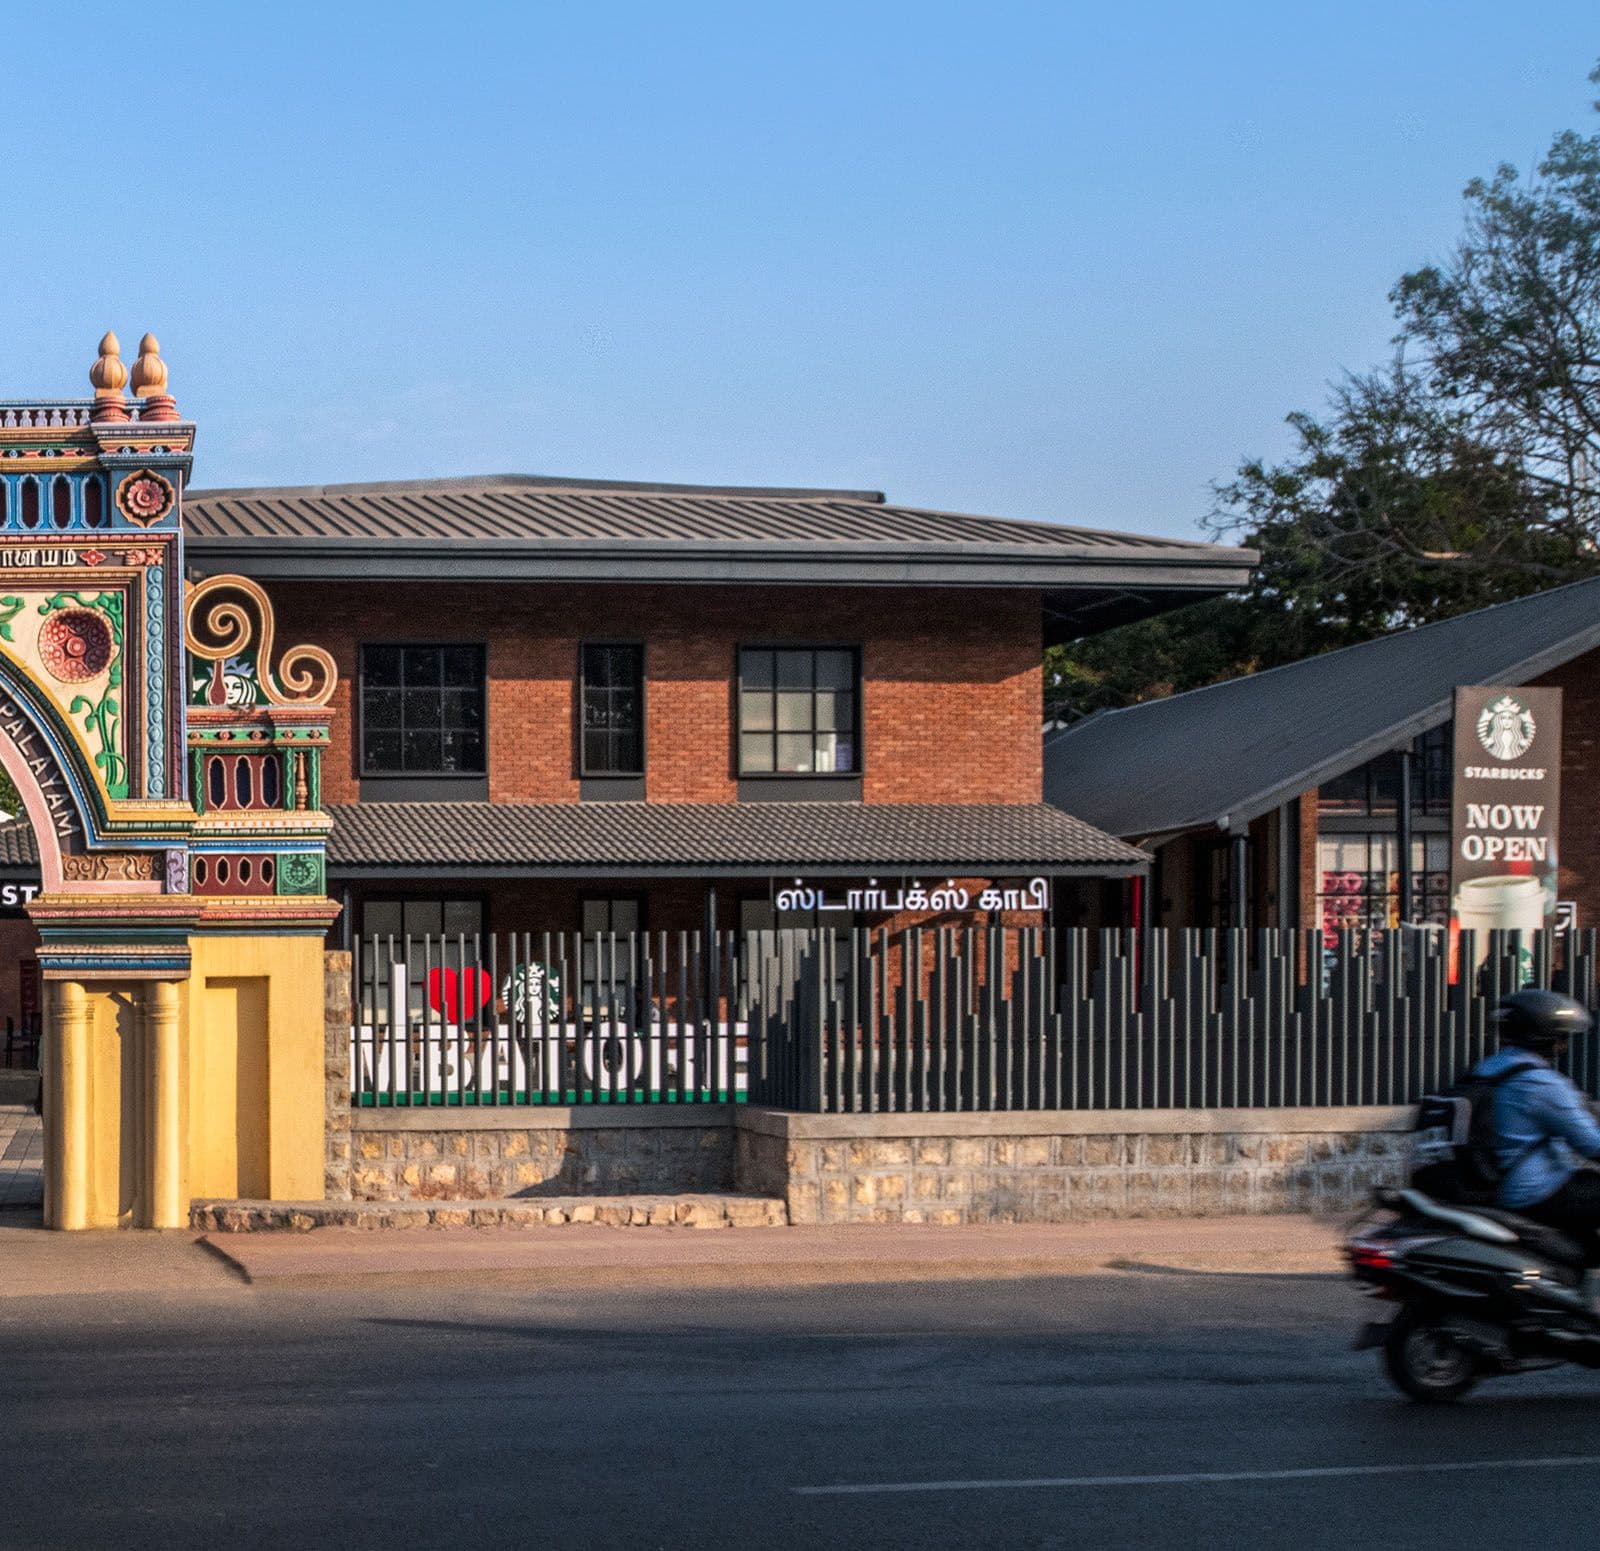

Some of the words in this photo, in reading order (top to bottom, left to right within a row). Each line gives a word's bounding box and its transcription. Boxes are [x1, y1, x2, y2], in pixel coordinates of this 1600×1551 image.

[1463, 766, 1546, 780] STARBUCKS
[1465, 803, 1545, 830] NOW
[1460, 835, 1547, 861] OPEN
[775, 878, 969, 911] ஸ்டார்பக்ஸ்
[978, 877, 1048, 911] காபி
